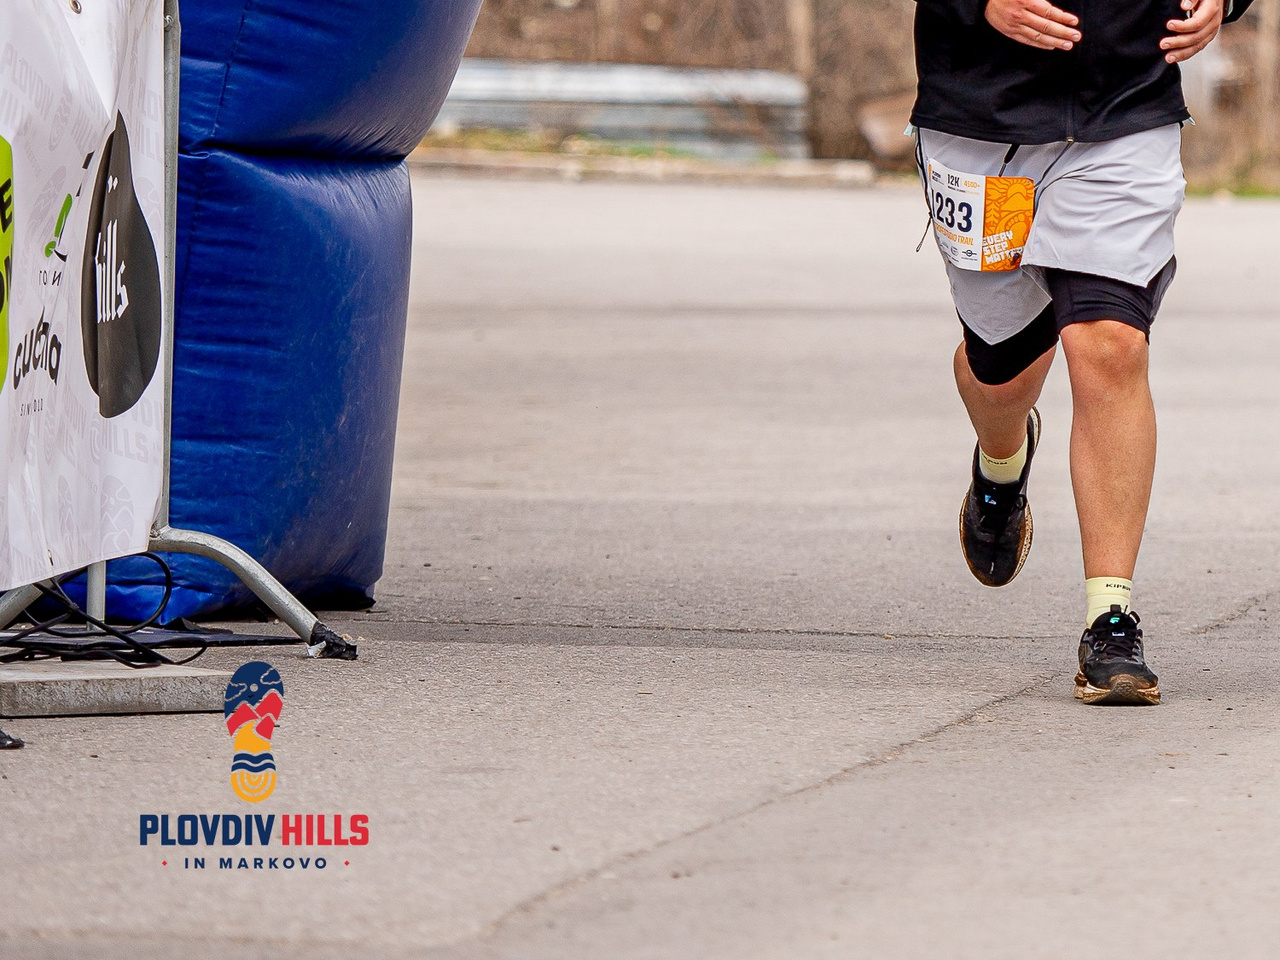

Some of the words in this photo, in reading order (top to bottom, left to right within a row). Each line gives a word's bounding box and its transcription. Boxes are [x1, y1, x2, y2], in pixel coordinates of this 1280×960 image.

[947, 174, 960, 188] 12K
[982, 230, 1013, 246] EVERY
[982, 241, 1009, 255] STEP
